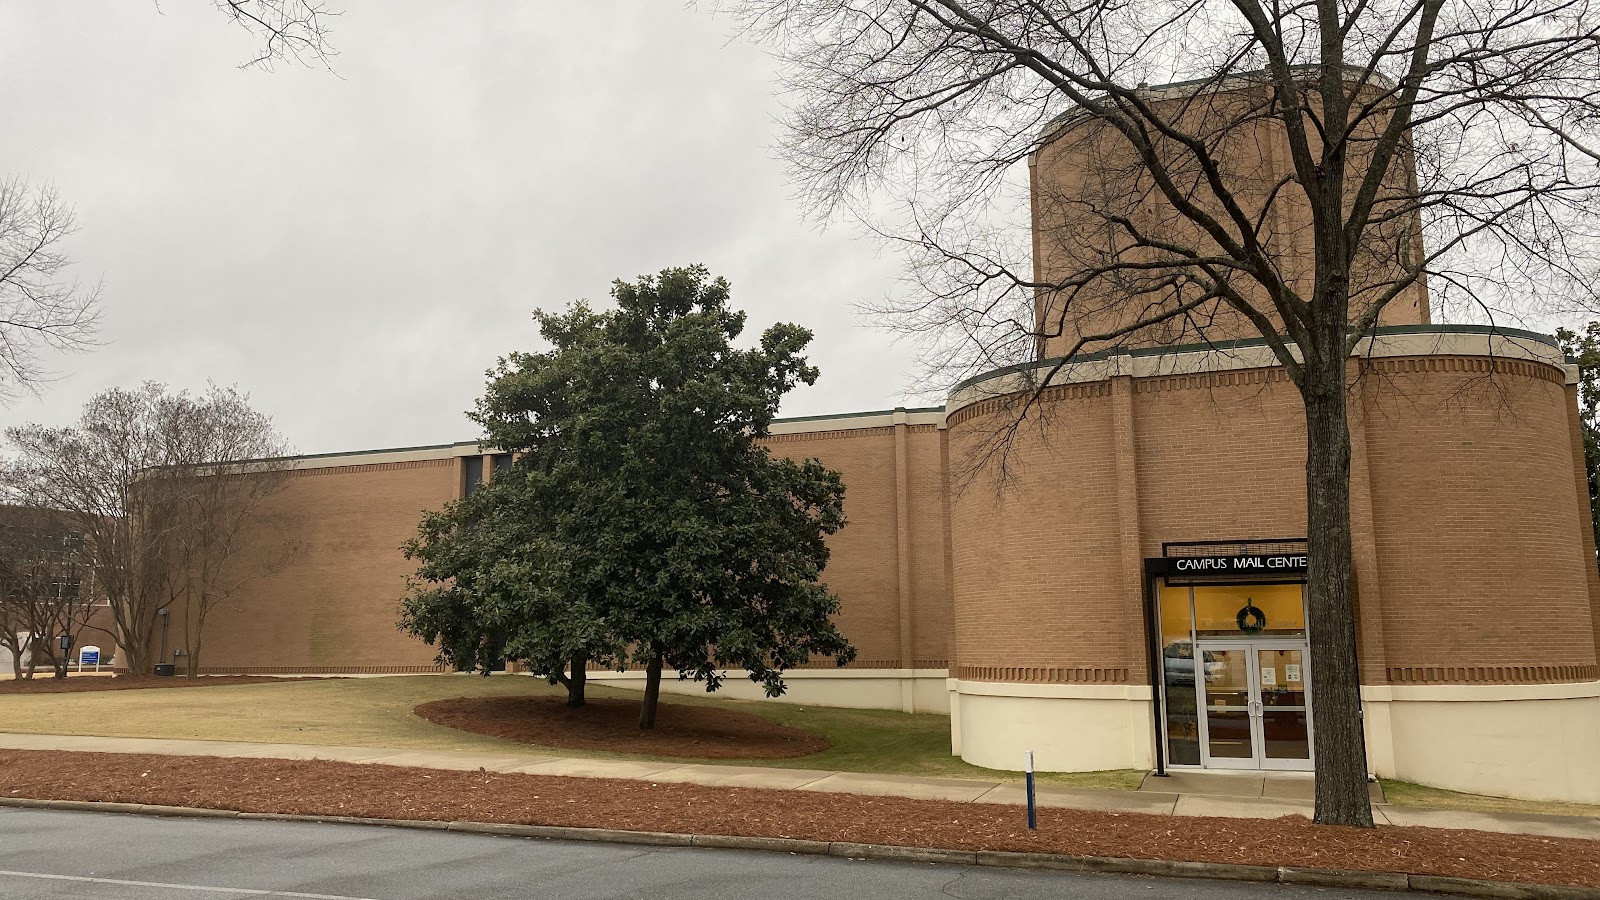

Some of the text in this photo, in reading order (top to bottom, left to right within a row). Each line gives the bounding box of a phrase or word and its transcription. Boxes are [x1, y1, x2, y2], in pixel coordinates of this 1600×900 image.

[1176, 556, 1307, 571] CAMPUS MAIL CENTE
